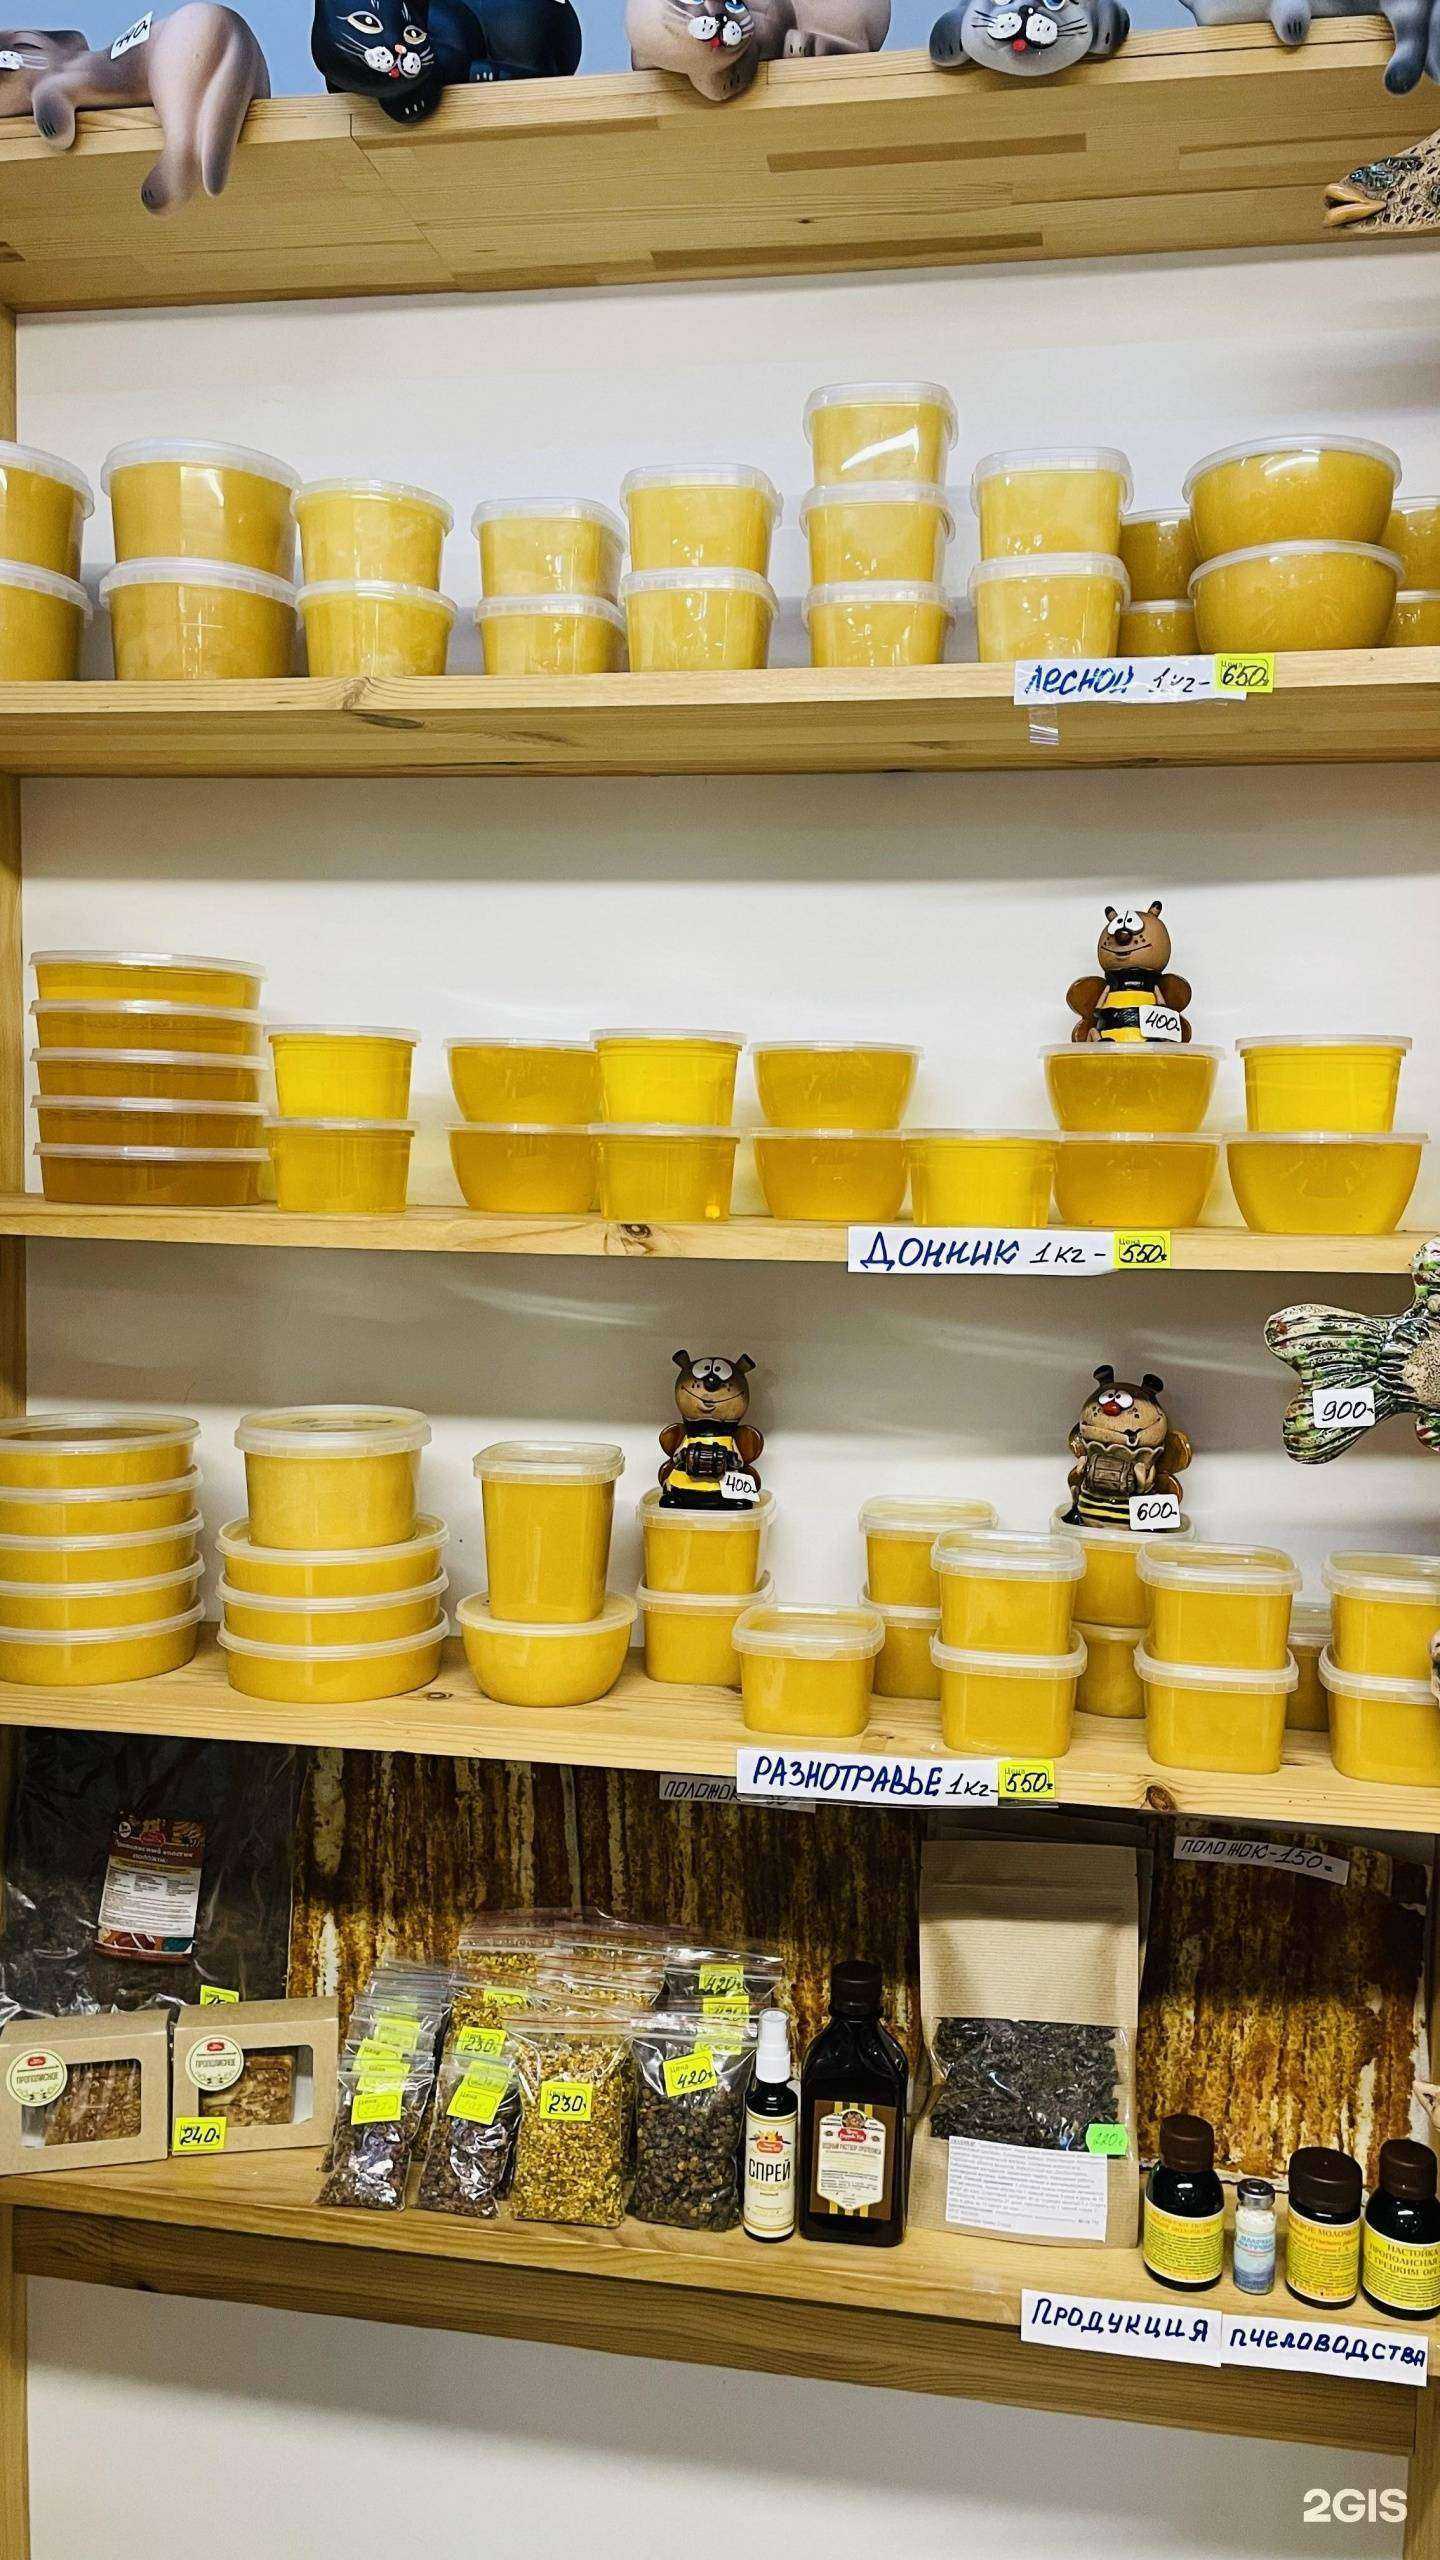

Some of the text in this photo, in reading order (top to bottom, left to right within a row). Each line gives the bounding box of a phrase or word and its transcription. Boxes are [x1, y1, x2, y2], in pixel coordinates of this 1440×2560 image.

[860, 1231, 1020, 1271] ДОННИК
[752, 1755, 943, 1797] РАЗНОТРАВЬЕ
[748, 2158, 791, 2182] СПРЕЙ
